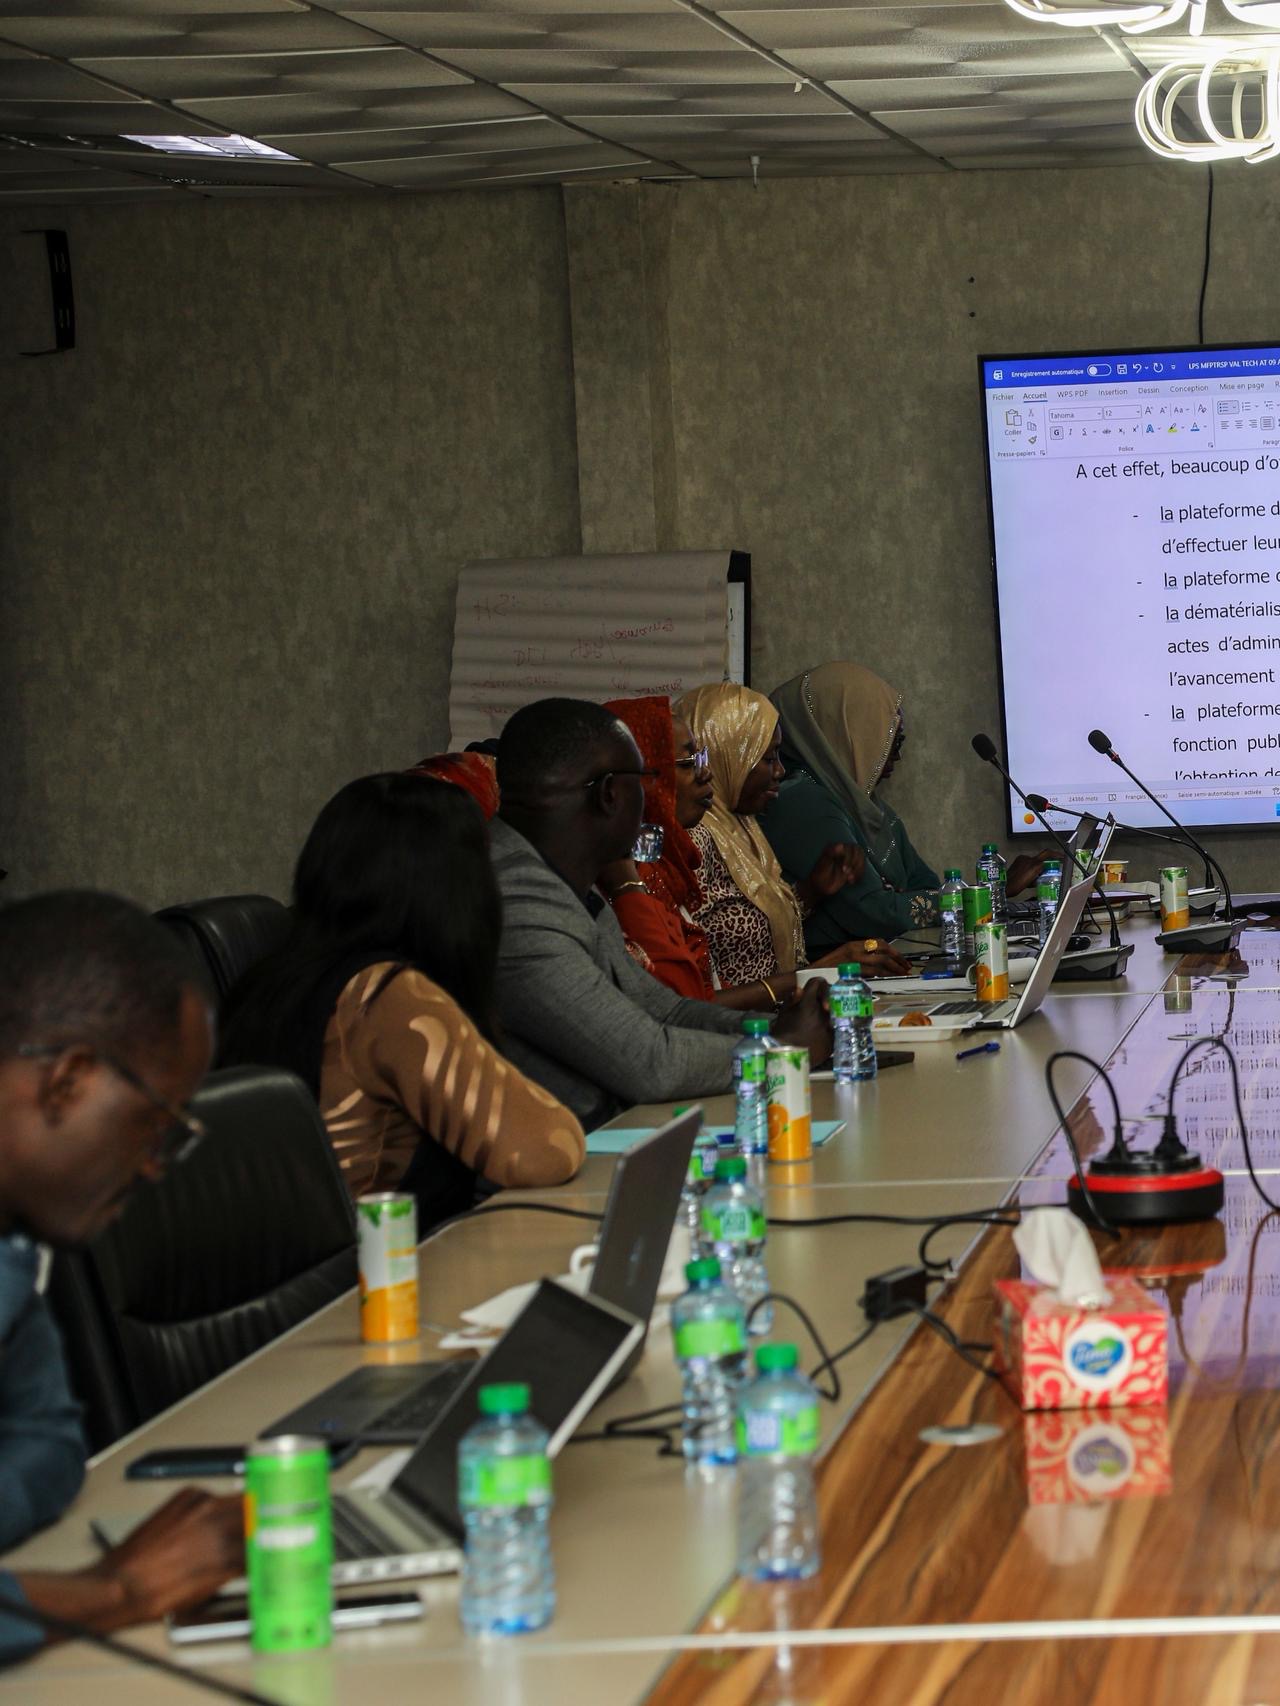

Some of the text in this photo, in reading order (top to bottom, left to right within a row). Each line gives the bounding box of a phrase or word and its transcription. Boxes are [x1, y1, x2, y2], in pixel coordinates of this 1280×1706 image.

[1098, 388, 1128, 396] Insertion
[1138, 386, 1160, 394] Dessin
[1170, 384, 1209, 394] Conception
[1219, 382, 1234, 390] Mise
[1246, 382, 1265, 391] page
[1075, 463, 1088, 479] A
[1092, 462, 1118, 479] cet
[1122, 460, 1165, 479] effet,
[1170, 457, 1250, 476] beaucoup
[1160, 505, 1174, 522] la
[1178, 502, 1266, 524] plateforme
[1161, 537, 1249, 555] d'effectuer
[1163, 571, 1179, 588] la
[1183, 569, 1271, 591] plateforme
[1165, 605, 1182, 622] la
[1167, 638, 1210, 654] actes
[1169, 668, 1276, 687] l'avancement
[1171, 704, 1186, 721] la
[1172, 737, 1237, 753] fonction
